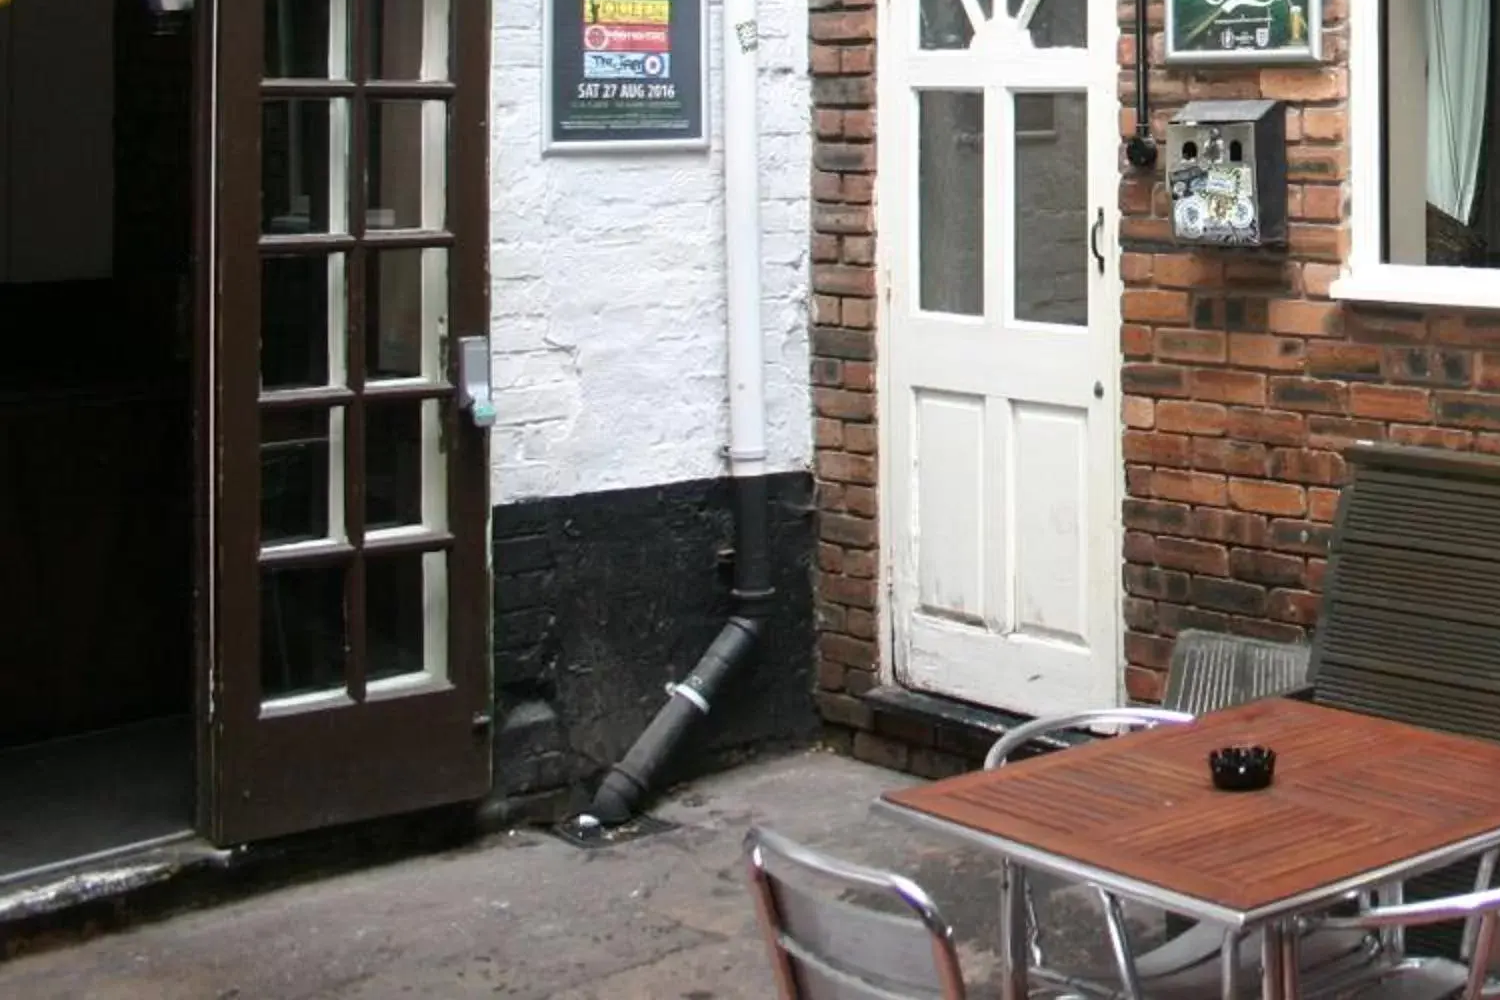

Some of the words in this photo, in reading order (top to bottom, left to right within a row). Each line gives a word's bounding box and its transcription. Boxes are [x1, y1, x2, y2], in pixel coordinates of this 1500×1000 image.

[577, 83, 600, 99] SAT
[602, 83, 617, 99] 27
[619, 83, 645, 99] AUG
[647, 83, 676, 99] 2016
